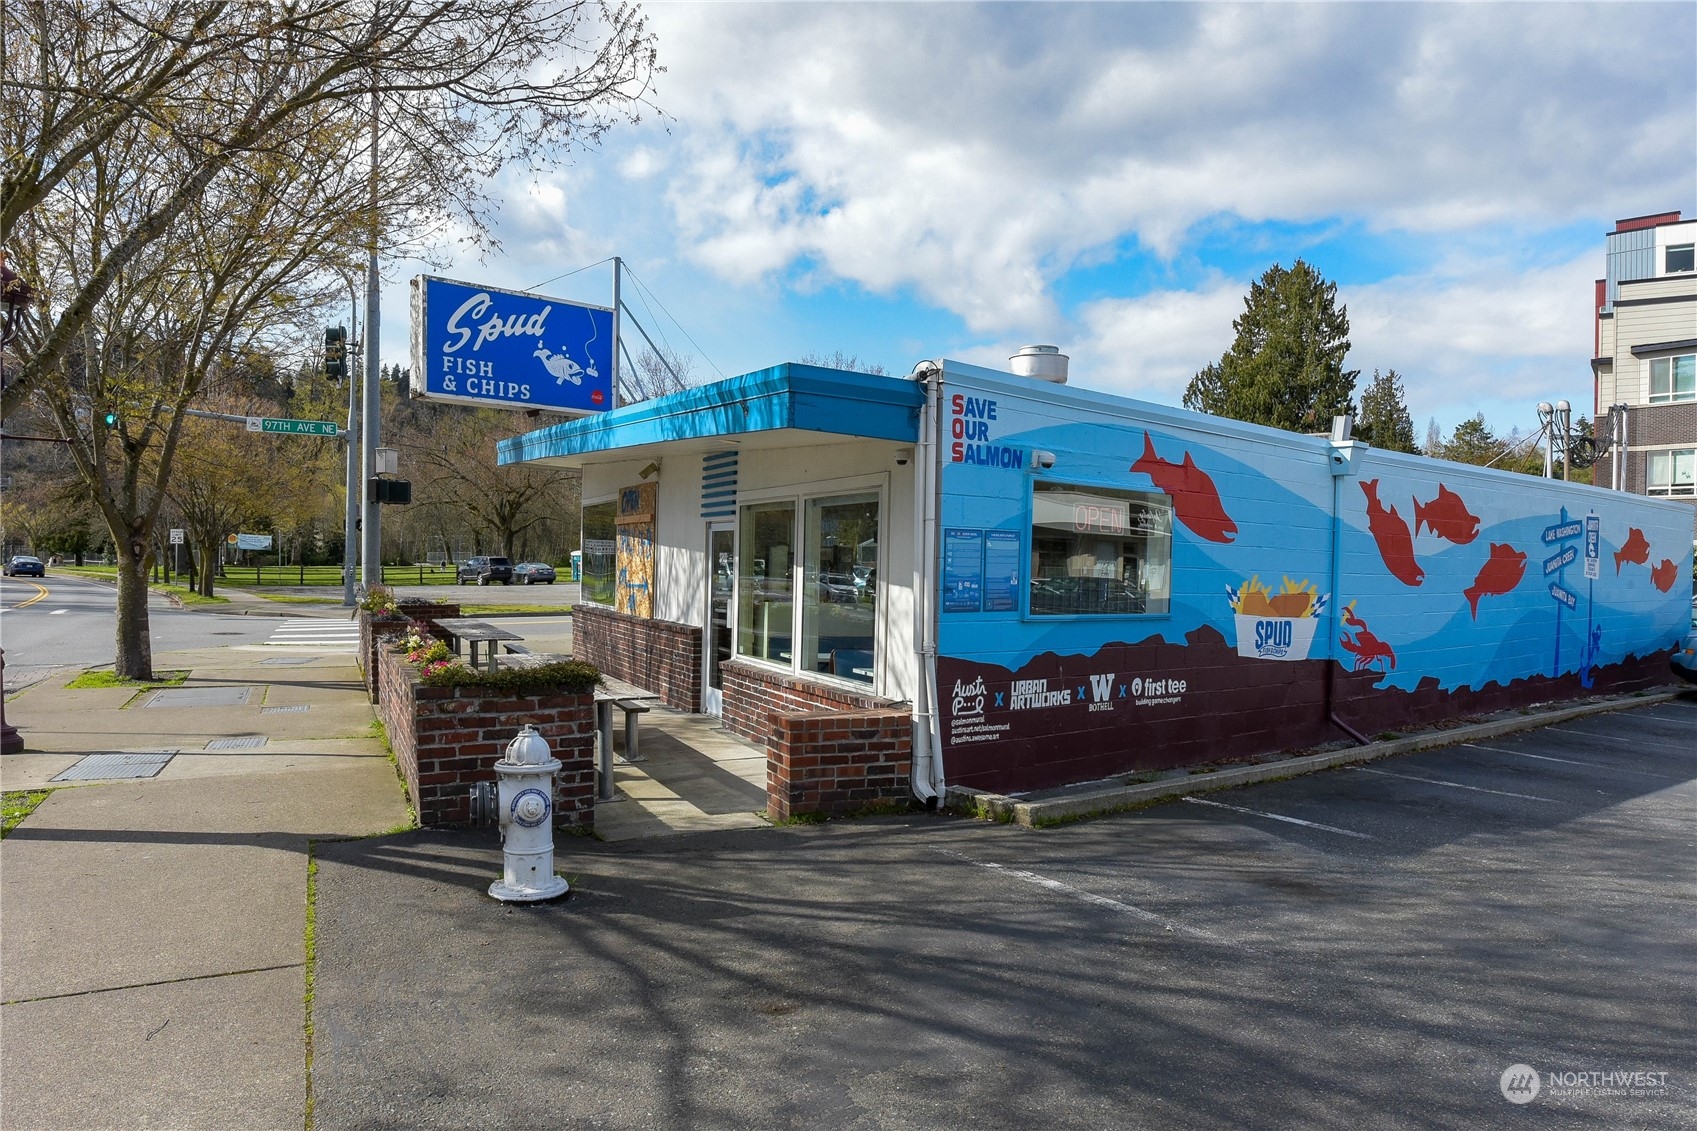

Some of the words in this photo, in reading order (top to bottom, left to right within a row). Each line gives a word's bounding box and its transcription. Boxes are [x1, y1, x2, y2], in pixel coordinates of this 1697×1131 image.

[443, 293, 551, 353] Spud
[443, 356, 493, 377] FISH
[443, 376, 456, 392] &
[466, 378, 530, 400] CHIPS
[952, 394, 997, 420] SAVE
[264, 421, 290, 431] 97TH
[297, 423, 316, 432] AVE
[322, 424, 334, 434] NE
[952, 418, 989, 442] OUR
[952, 442, 1023, 469] SALMON
[1076, 506, 1122, 532] OPEN
[1545, 529, 1556, 541] LAKE
[1556, 524, 1581, 538] WASHINGTON
[1562, 550, 1575, 564] CREEK
[1255, 620, 1292, 650] SPUD
[1011, 679, 1046, 696] URBAN
[1090, 674, 1115, 702] W
[1145, 678, 1166, 696] first
[1168, 679, 1187, 693] tee
[1010, 690, 1071, 710] ARTWORKS
[1089, 702, 1114, 712] BOTHELL
